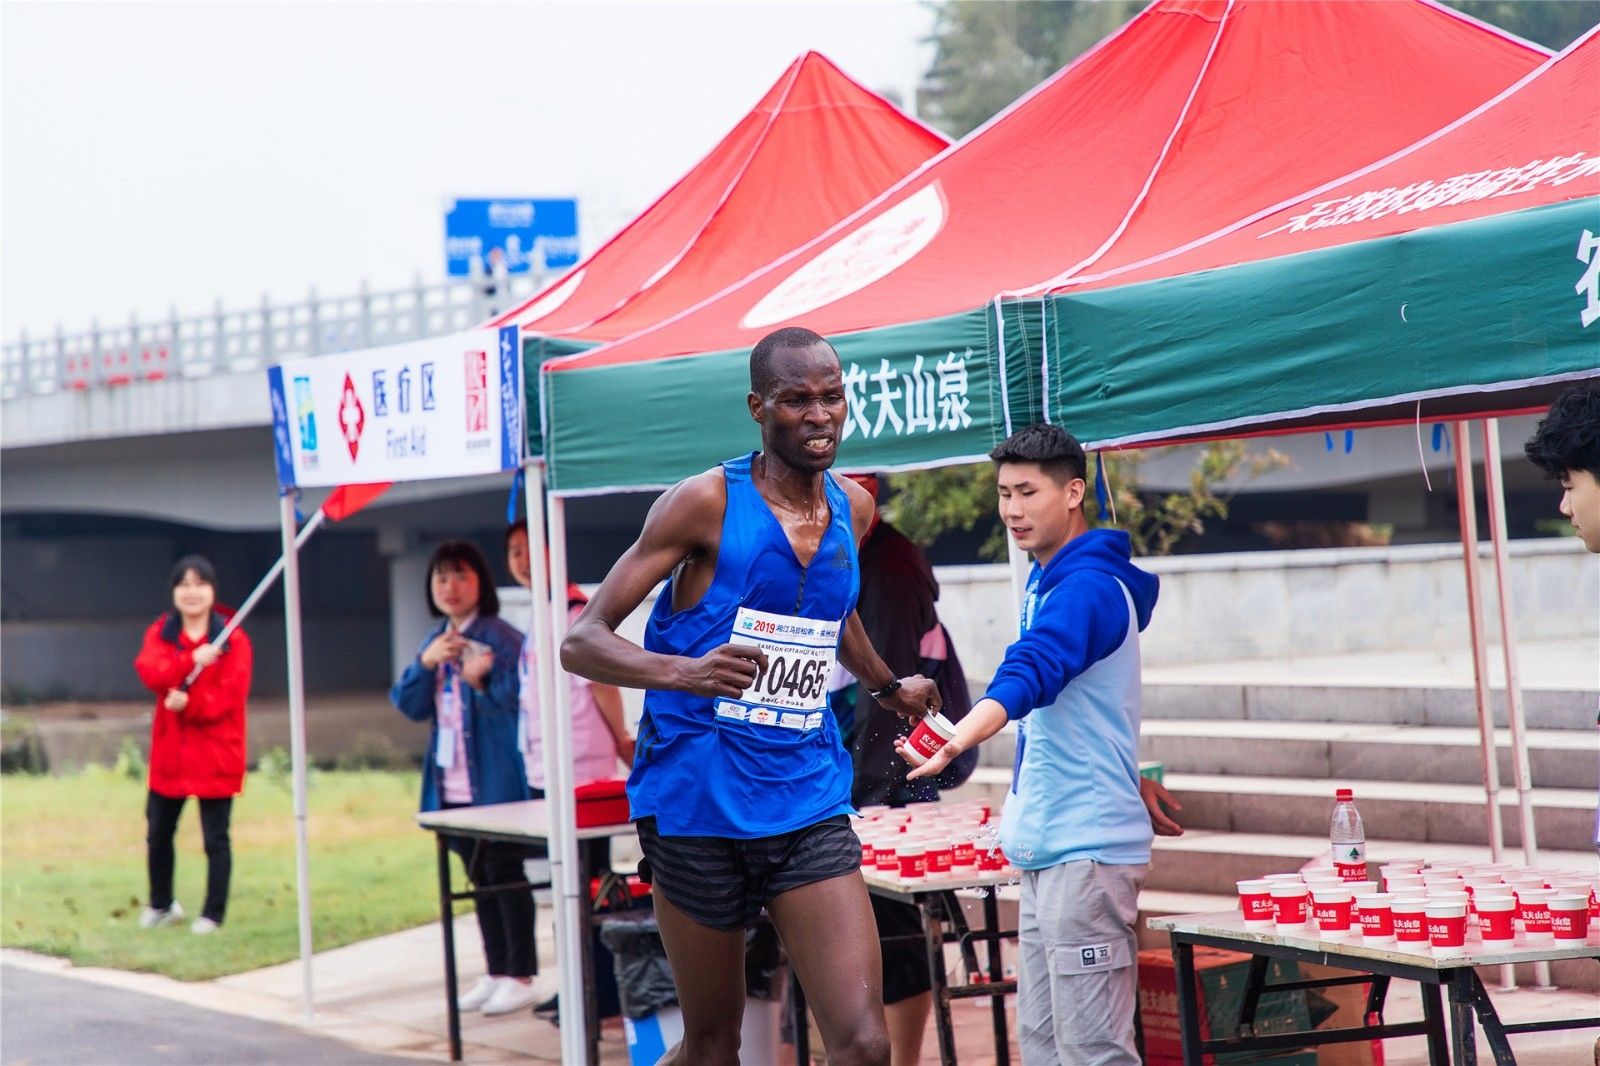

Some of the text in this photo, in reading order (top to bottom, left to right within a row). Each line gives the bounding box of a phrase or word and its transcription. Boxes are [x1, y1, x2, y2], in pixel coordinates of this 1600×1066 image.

[372, 362, 435, 417] 医疗区
[842, 351, 973, 441] 农夫山泉
[757, 642, 783, 653] SAMSON
[754, 654, 828, 700] 10465
